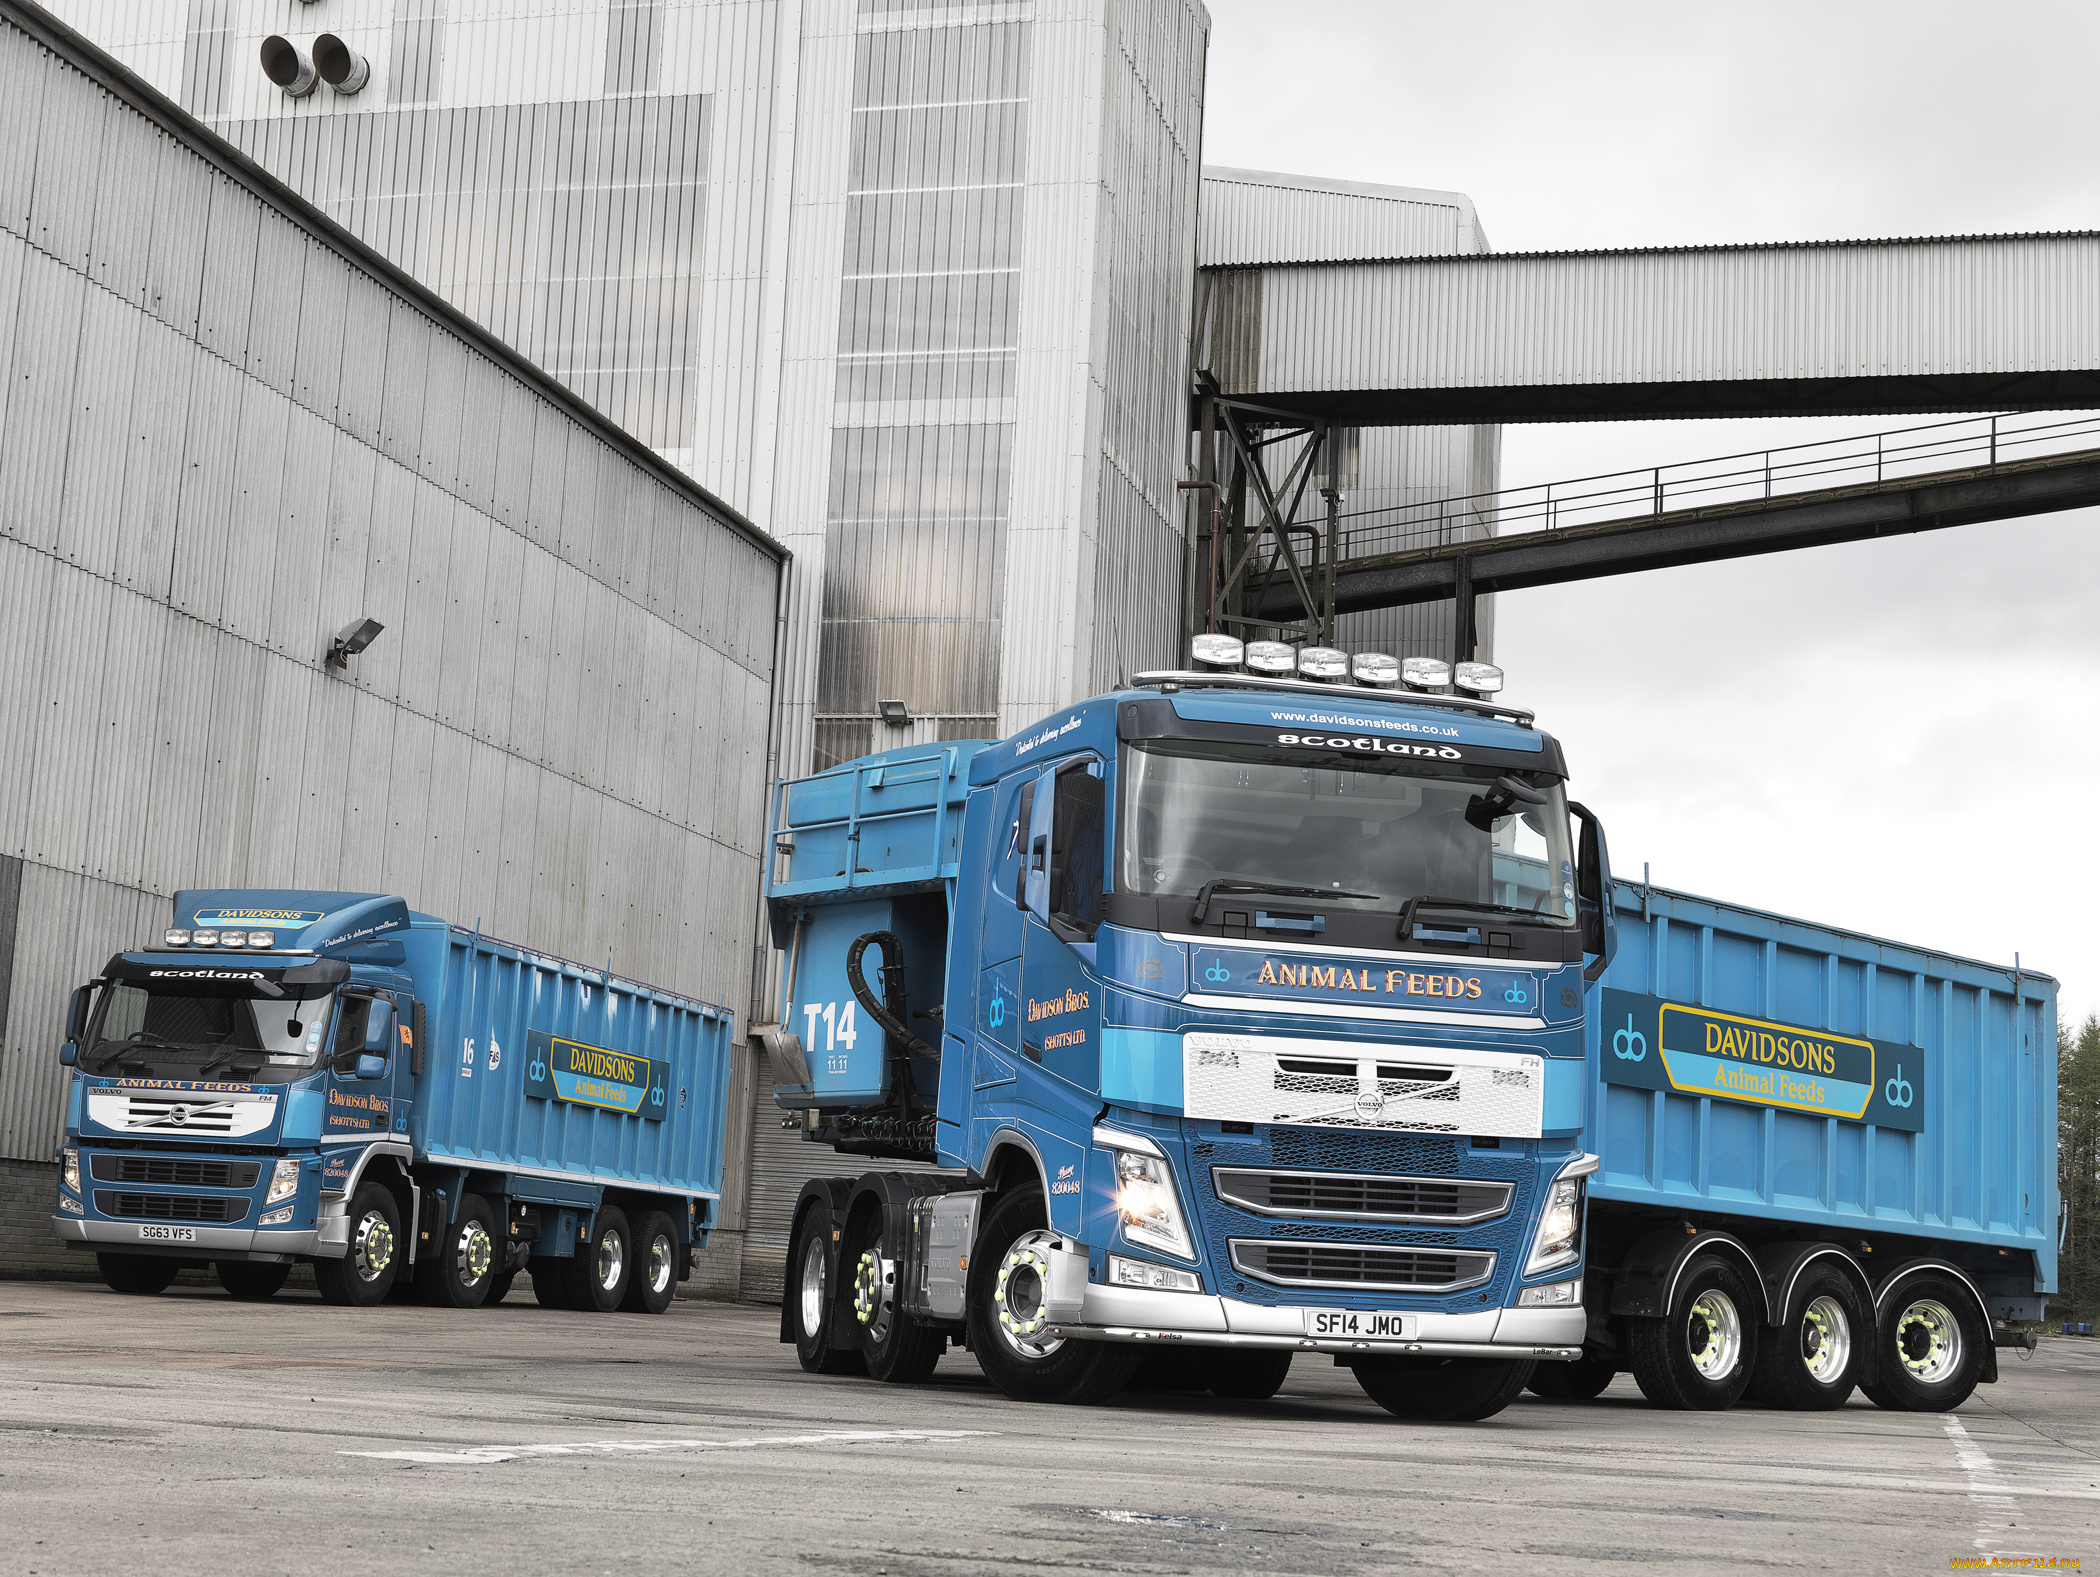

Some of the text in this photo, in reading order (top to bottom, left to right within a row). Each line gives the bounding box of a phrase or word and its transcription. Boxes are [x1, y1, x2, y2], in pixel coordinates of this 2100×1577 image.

[1270, 711, 1460, 738] www.davidsonsfeeds.co.uk
[1277, 734, 1462, 760] scotland
[217, 910, 303, 920] DAVIDSONS
[149, 970, 265, 980] scotland
[1256, 960, 1483, 1000] ANIMAL FEEDS
[1028, 997, 1064, 1024] DAVIDSON
[803, 1000, 857, 1052] T14
[462, 1037, 475, 1065] 16
[1188, 1035, 1254, 1049] VOLVO
[1704, 1022, 1836, 1075] DAVIDSONS
[570, 1047, 635, 1083] DAVIDSONS
[827, 1058, 848, 1070] 11 11
[1521, 1057, 1540, 1067] FH
[116, 1078, 252, 1093] ANIMAL FEEDS
[575, 1077, 627, 1103] Animal Feeds
[1714, 1063, 1825, 1104] Animal Feeds
[329, 1088, 368, 1110] DAVIDSON
[329, 1114, 359, 1128] (SHOTTS)
[324, 1167, 349, 1178] 820048
[1051, 1180, 1080, 1196] 820048
[143, 1226, 192, 1240] SG63 VFS
[1316, 1313, 1403, 1336] SF14 JMO
[1158, 1332, 1183, 1341] Kelsa
